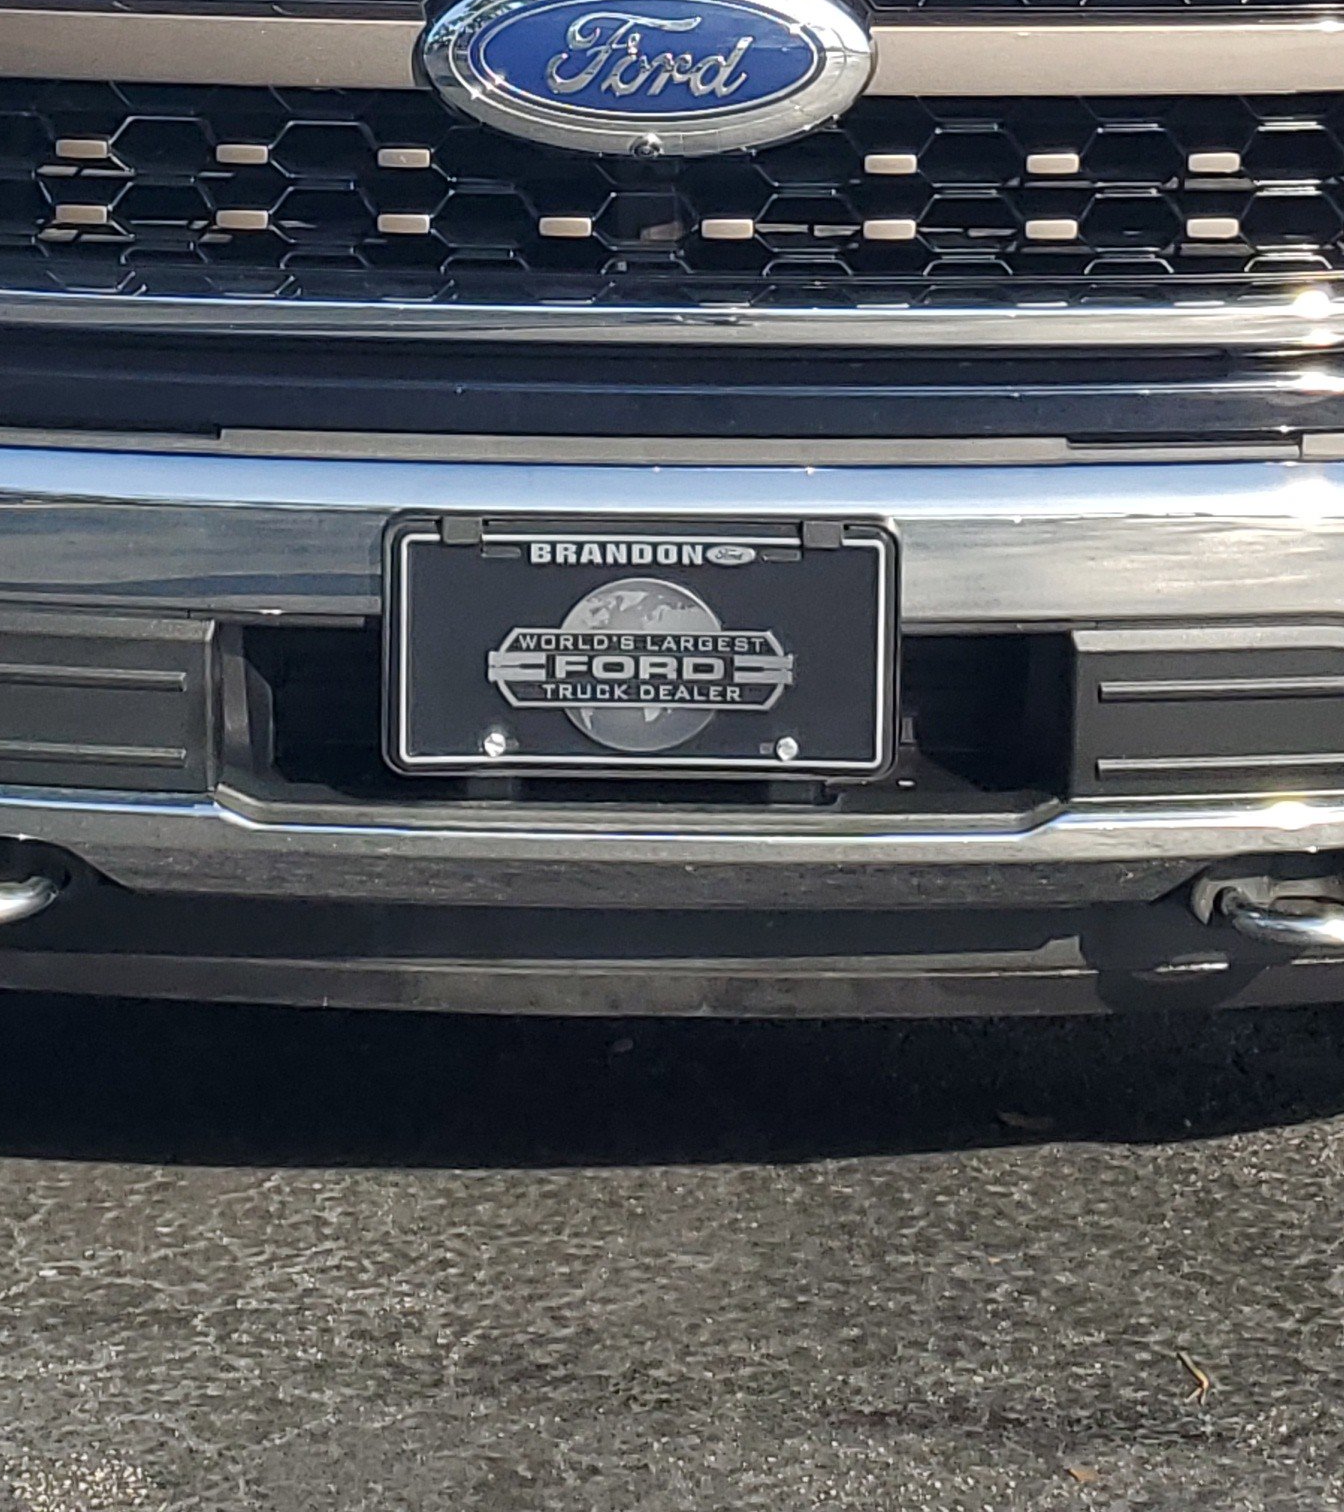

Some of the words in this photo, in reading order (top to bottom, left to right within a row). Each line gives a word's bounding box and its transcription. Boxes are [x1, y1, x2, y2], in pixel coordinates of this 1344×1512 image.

[547, 11, 754, 98] Ford
[530, 542, 703, 565] BRANDON
[518, 635, 635, 651] WORLD'S
[646, 636, 765, 653] LARGEST
[555, 655, 726, 681] FORD
[542, 683, 630, 700] TRUCK
[640, 684, 742, 702] DEALER
